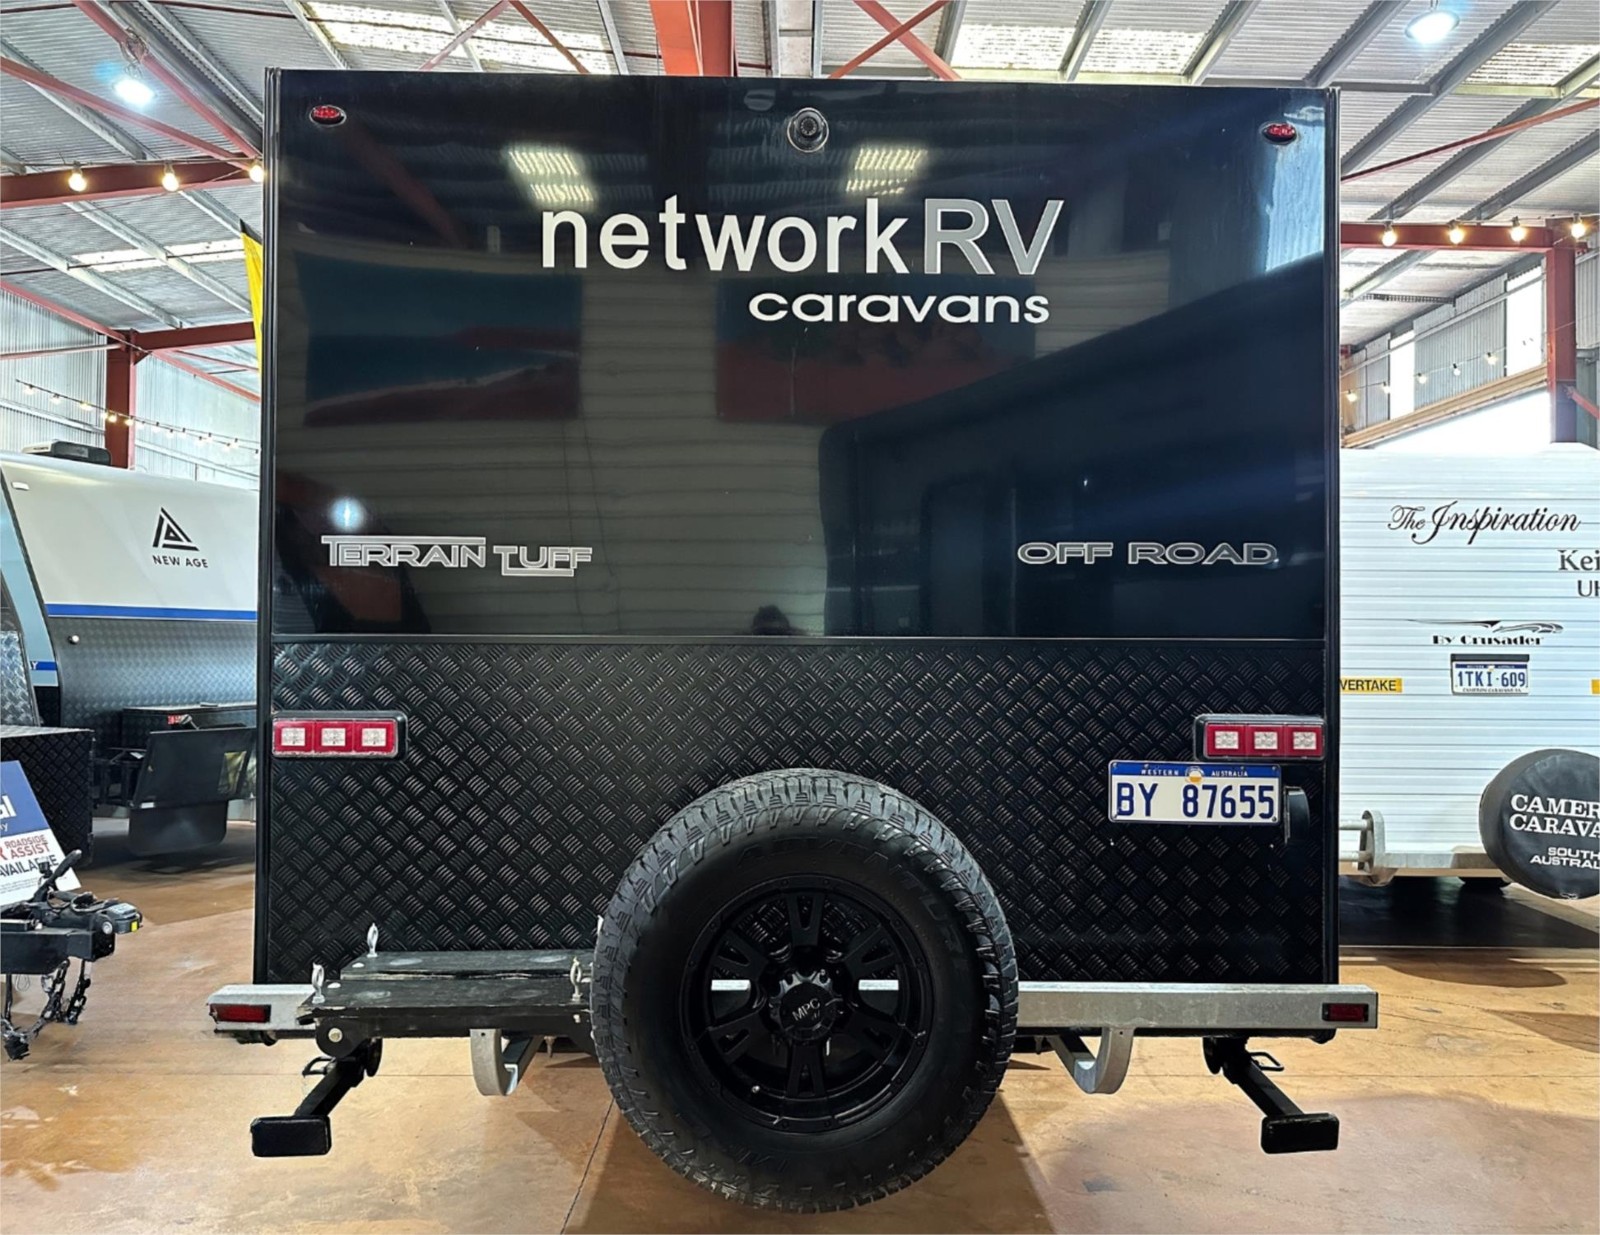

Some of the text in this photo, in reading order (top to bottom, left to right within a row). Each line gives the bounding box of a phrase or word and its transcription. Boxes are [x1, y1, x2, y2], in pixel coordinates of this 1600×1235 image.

[748, 292, 1050, 324] caravans
[1387, 500, 1582, 545] The Inspiration
[152, 554, 209, 569] NEW AGE
[321, 535, 593, 577] TERRAIN TUFF
[1017, 542, 1279, 565] OFF ROAD
[1459, 635, 1544, 646] Crusader
[1140, 769, 1249, 778] WESTERN AUSTRALIA
[1116, 782, 1275, 819] BY 87655
[4, 834, 48, 849] ROADSIDE
[10, 842, 51, 859] ASSIST
